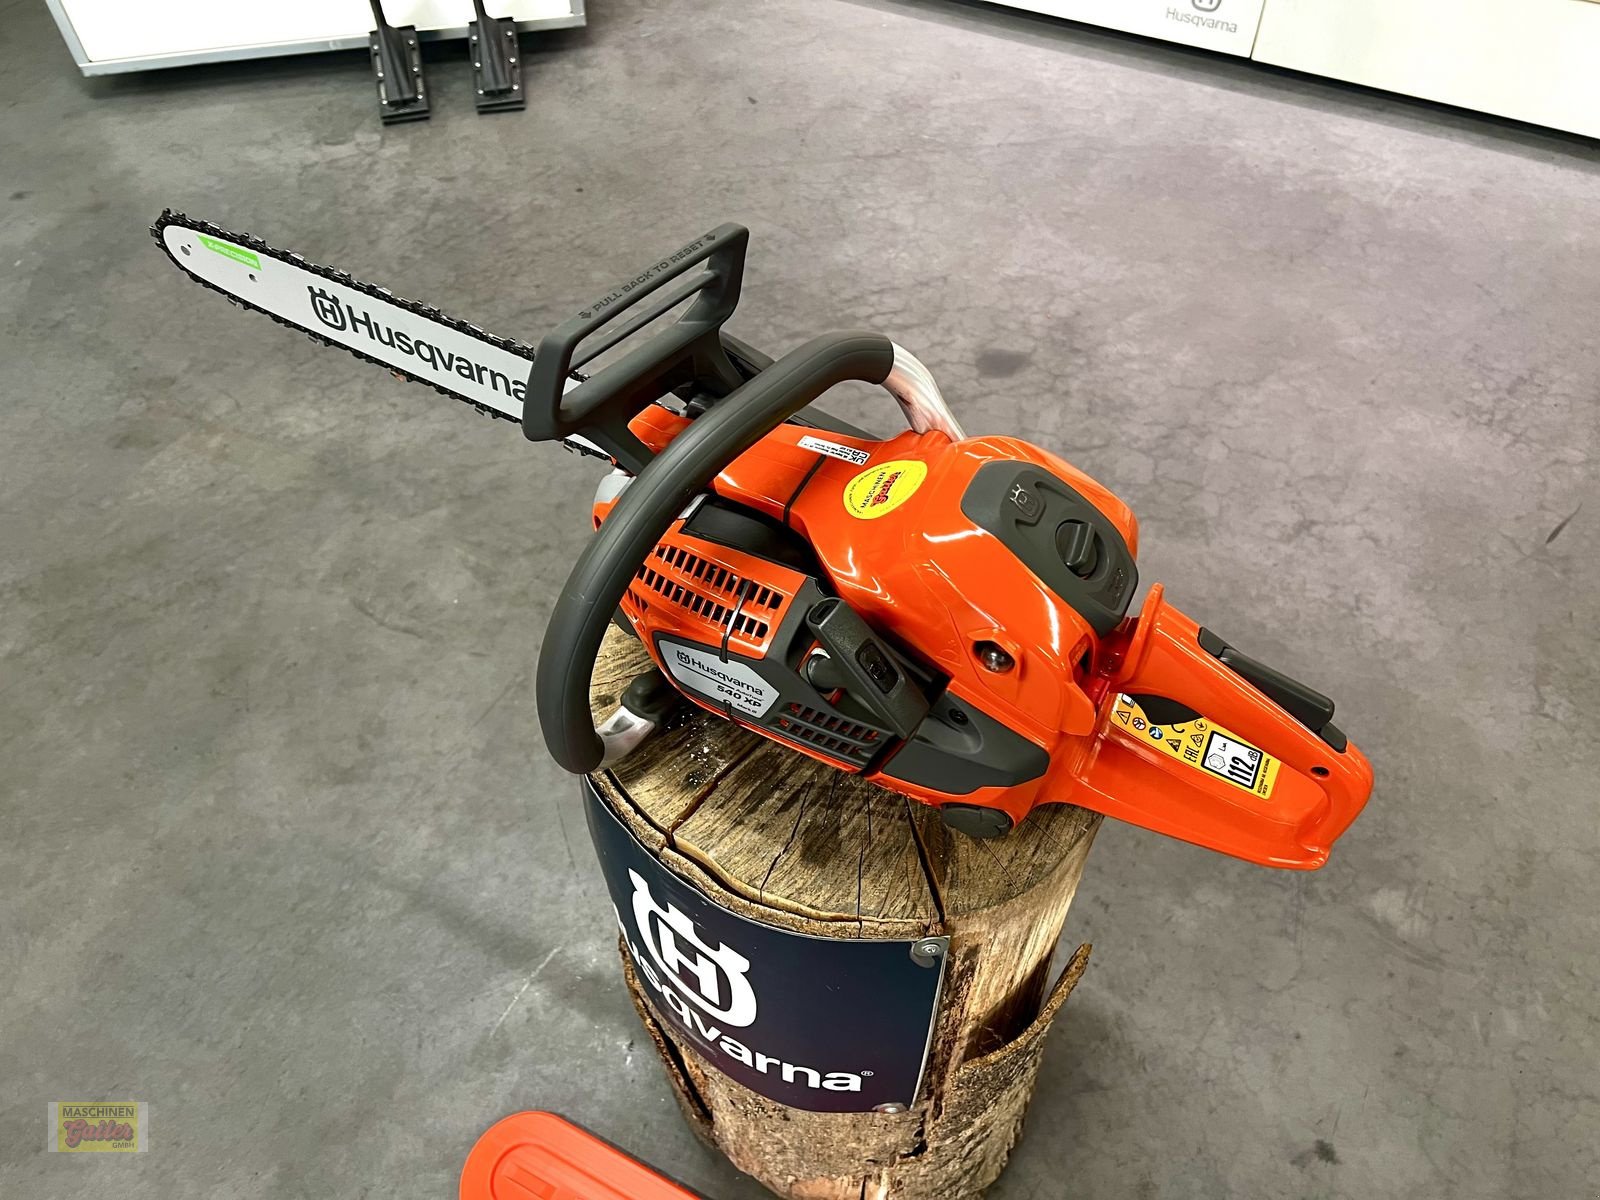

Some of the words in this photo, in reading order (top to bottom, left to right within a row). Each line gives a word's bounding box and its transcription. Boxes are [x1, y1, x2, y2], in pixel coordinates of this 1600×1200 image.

[1165, 7, 1238, 33] Husqvarna
[592, 293, 622, 312] PULL
[621, 271, 654, 293] BACK
[652, 261, 670, 273] TO
[669, 240, 705, 264] RESET
[860, 471, 887, 509] MASCHINEN
[691, 657, 764, 697] Husqvarna
[716, 684, 742, 700] 540
[744, 696, 762, 708] XP
[1227, 756, 1256, 783] 112
[1247, 750, 1258, 762] dB
